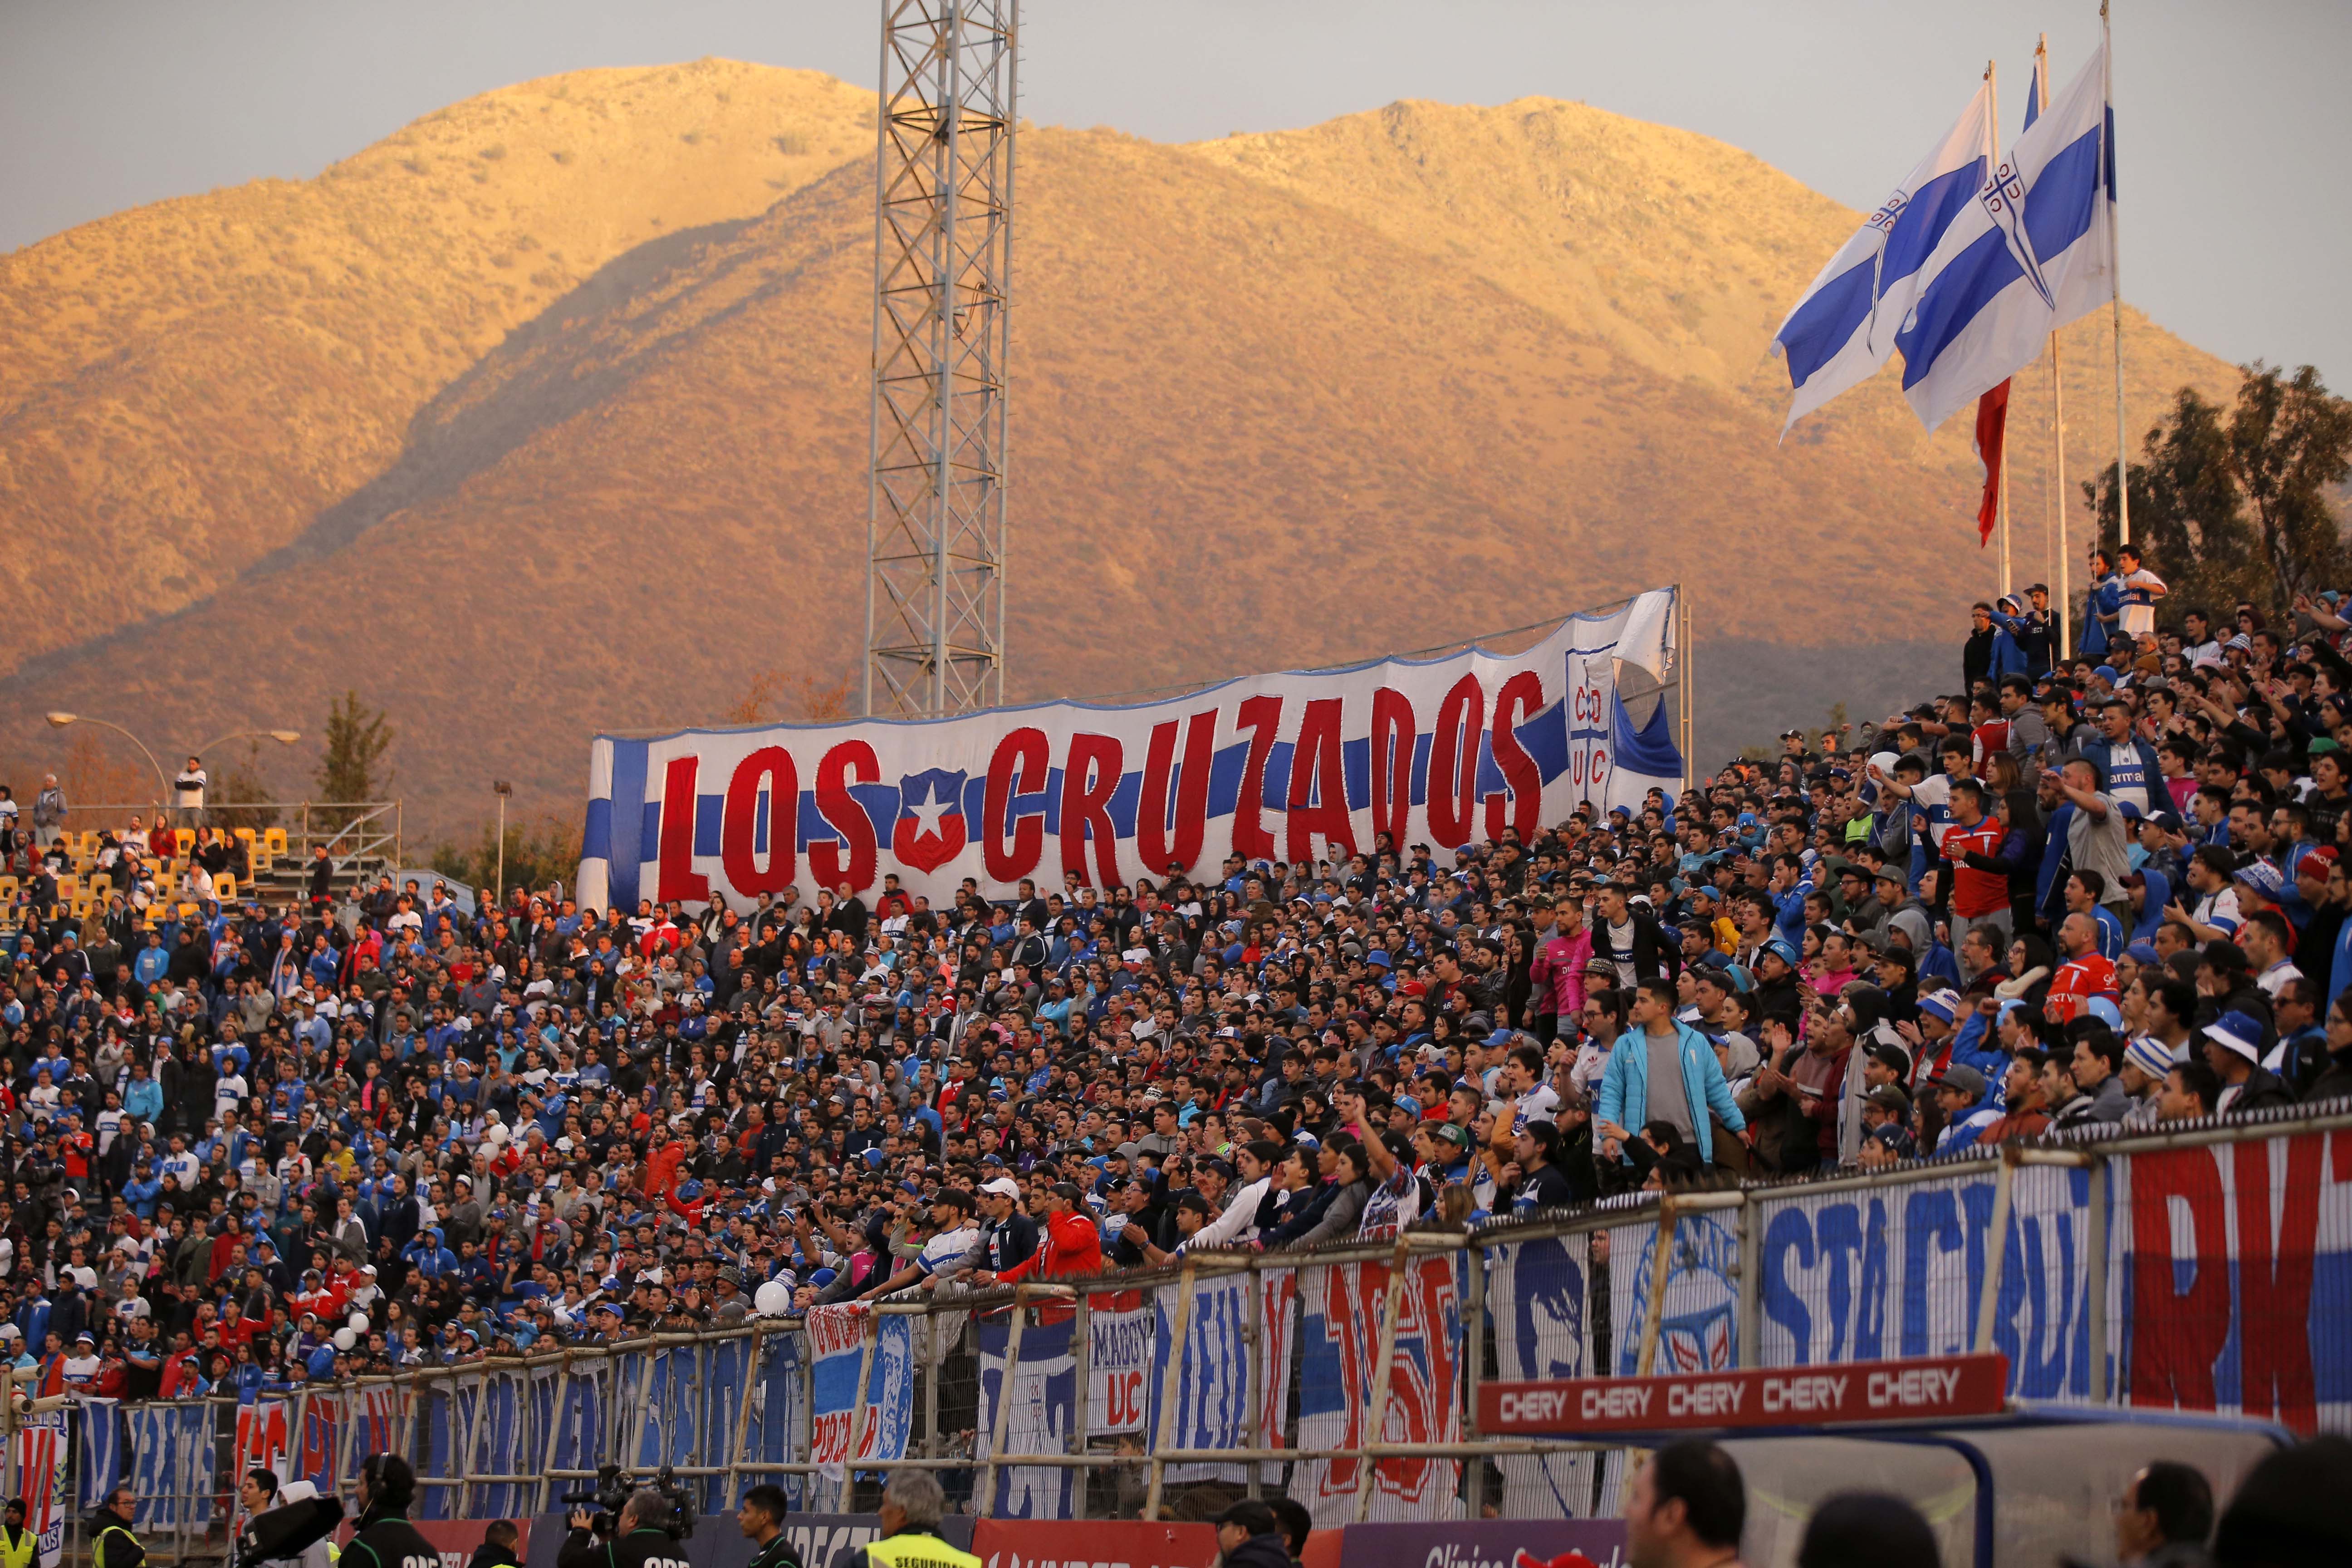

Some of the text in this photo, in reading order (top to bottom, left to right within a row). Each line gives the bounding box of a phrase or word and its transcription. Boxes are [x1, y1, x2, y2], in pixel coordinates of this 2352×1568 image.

[657, 669, 1544, 903] LOS CRUZADOS
[2110, 771, 2145, 784] armal
[1107, 1370, 1142, 1428] UC
[1500, 1367, 1960, 1422] CHERY CHERY CHERY CHERY CHERY
